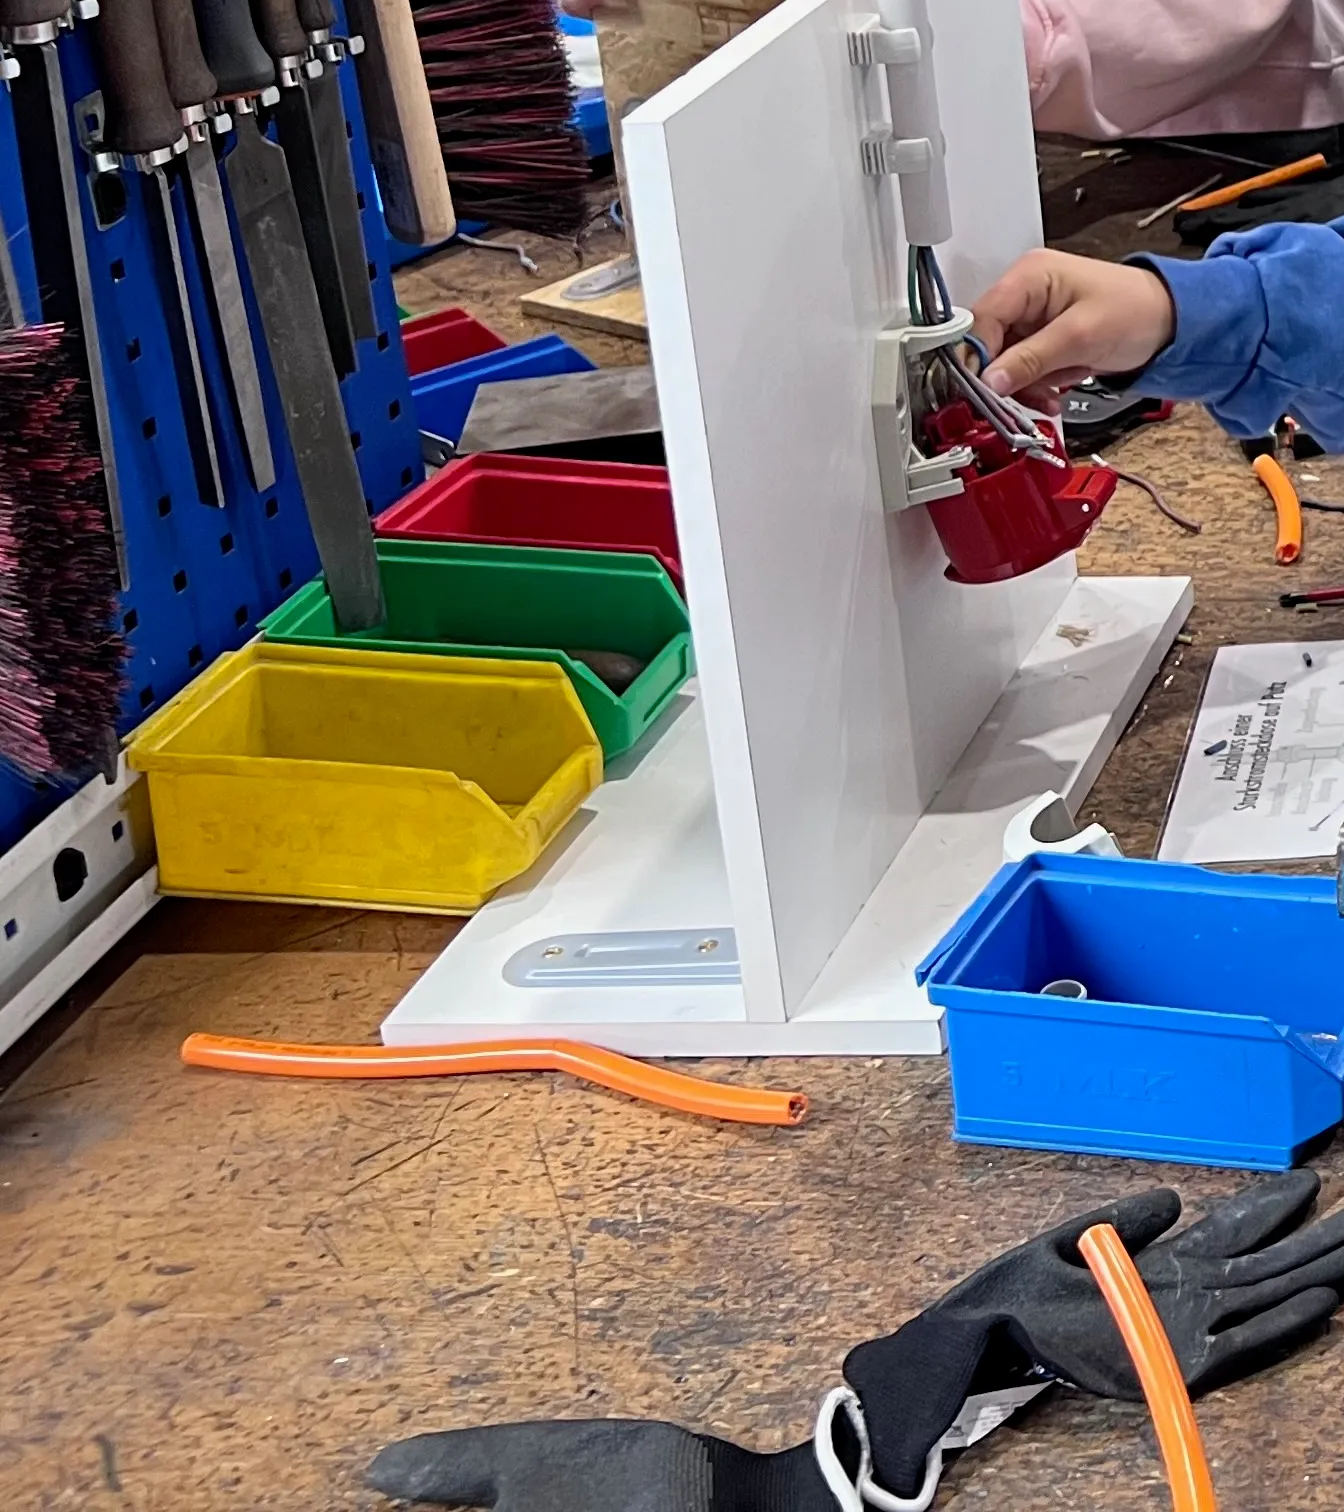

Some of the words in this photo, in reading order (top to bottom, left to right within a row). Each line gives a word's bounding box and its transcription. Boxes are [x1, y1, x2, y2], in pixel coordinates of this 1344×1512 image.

[1260, 681, 1288, 700] Putz
[1257, 702, 1282, 717] auf
[1228, 714, 1253, 737] einer
[1214, 738, 1247, 782] Anschluss
[1232, 719, 1278, 811] Starkstromsteckdose
